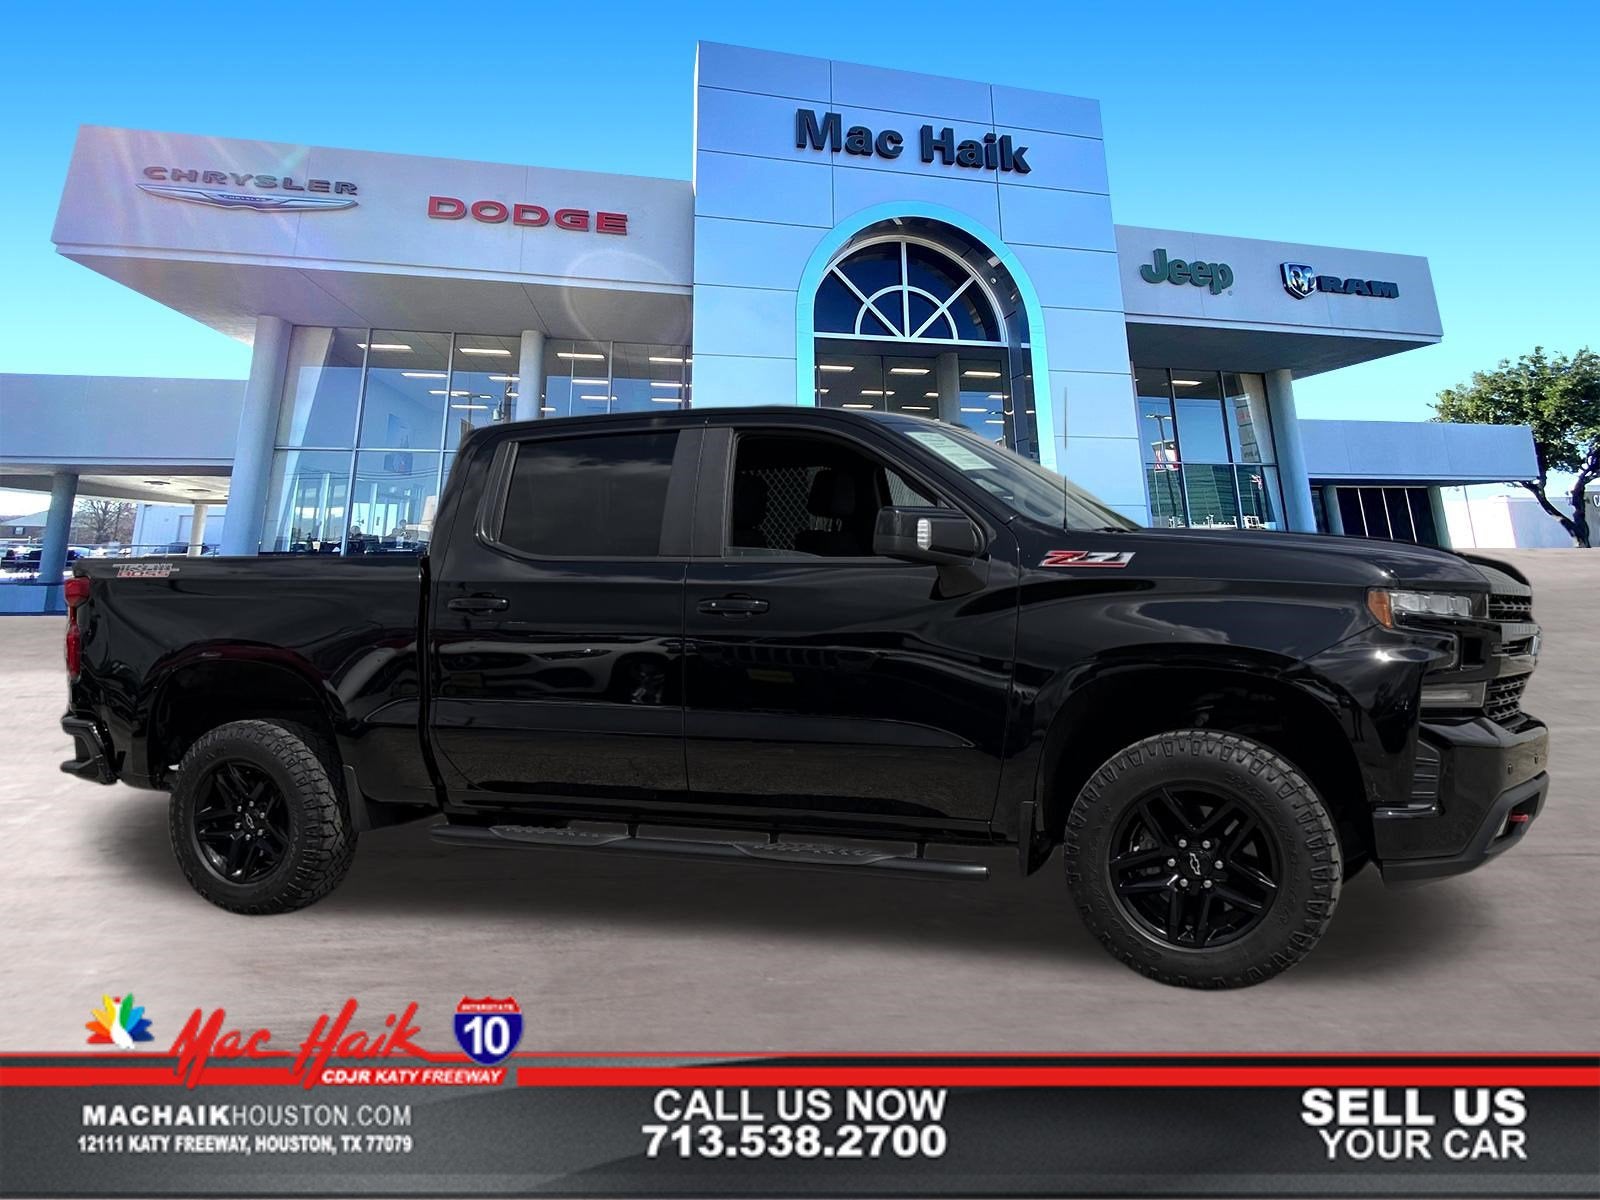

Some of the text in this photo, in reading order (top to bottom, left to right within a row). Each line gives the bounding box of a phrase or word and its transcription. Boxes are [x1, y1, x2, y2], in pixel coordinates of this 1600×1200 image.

[796, 108, 1032, 174] Mac Haik
[143, 166, 358, 196] CHRYSLER
[428, 195, 628, 236] DODGE
[1139, 248, 1234, 295] Jeep
[1315, 275, 1400, 299] RAM
[1038, 550, 1136, 568] Z71
